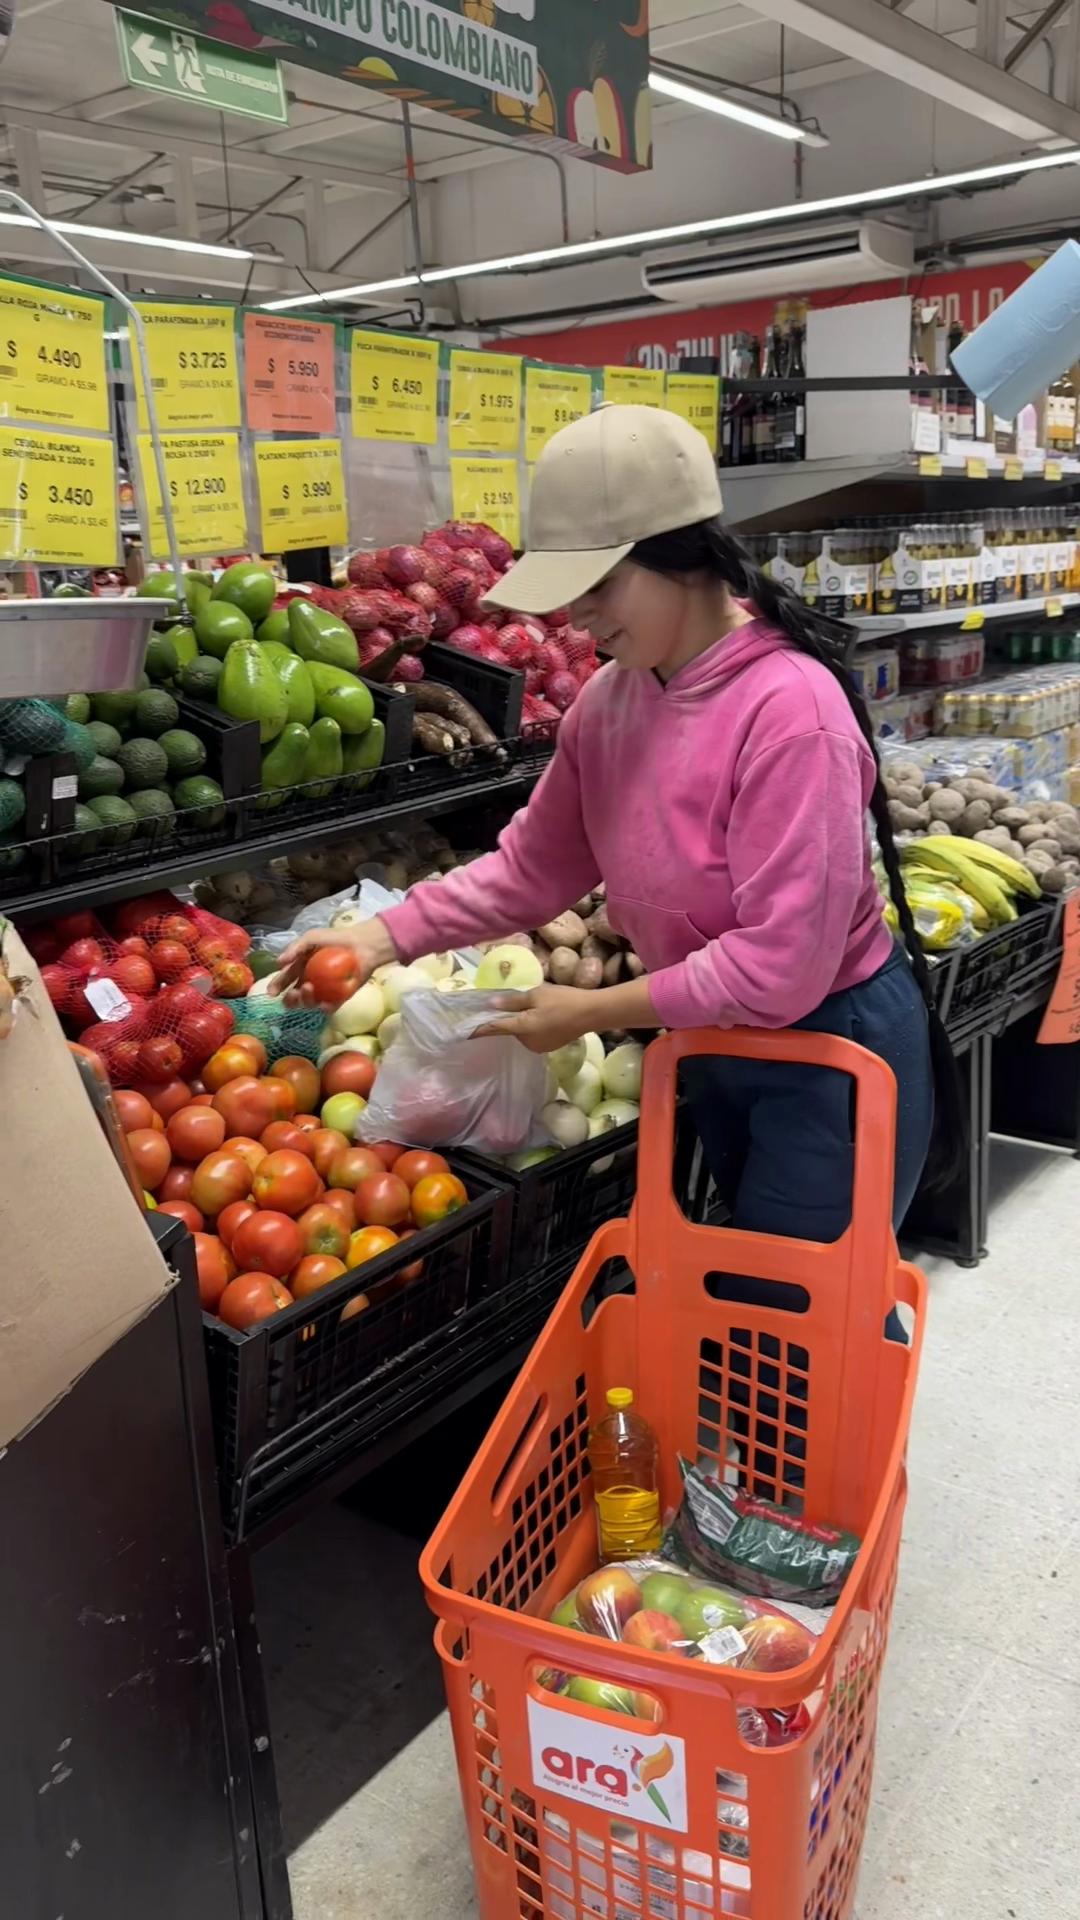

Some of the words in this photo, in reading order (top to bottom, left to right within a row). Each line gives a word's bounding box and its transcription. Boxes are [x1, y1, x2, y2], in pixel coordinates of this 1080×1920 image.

[381, 0, 534, 95] COLOMBIANO
[7, 340, 17, 358] $
[38, 346, 81, 369] 4.490
[178, 351, 187, 369] $
[190, 352, 227, 369] 3.725
[268, 358, 275, 374] $
[288, 360, 319, 377] 5.950
[36, 373, 68, 387] GRAMO
[372, 375, 379, 391] $
[392, 378, 422, 395] 6.450
[480, 394, 487, 407] $
[489, 394, 514, 408] 1.975
[48, 442, 81, 453] BLANCA
[18, 482, 29, 500] $
[48, 485, 93, 506] 3.450
[170, 481, 178, 497] $
[185, 477, 226, 497] 12.900
[282, 485, 290, 499] $
[303, 481, 331, 498] 3.990
[47, 513, 78, 526] GRAMO
[541, 1746, 628, 1798] ara
[580, 1786, 603, 1798] mejor
[604, 1795, 630, 1807] precio
